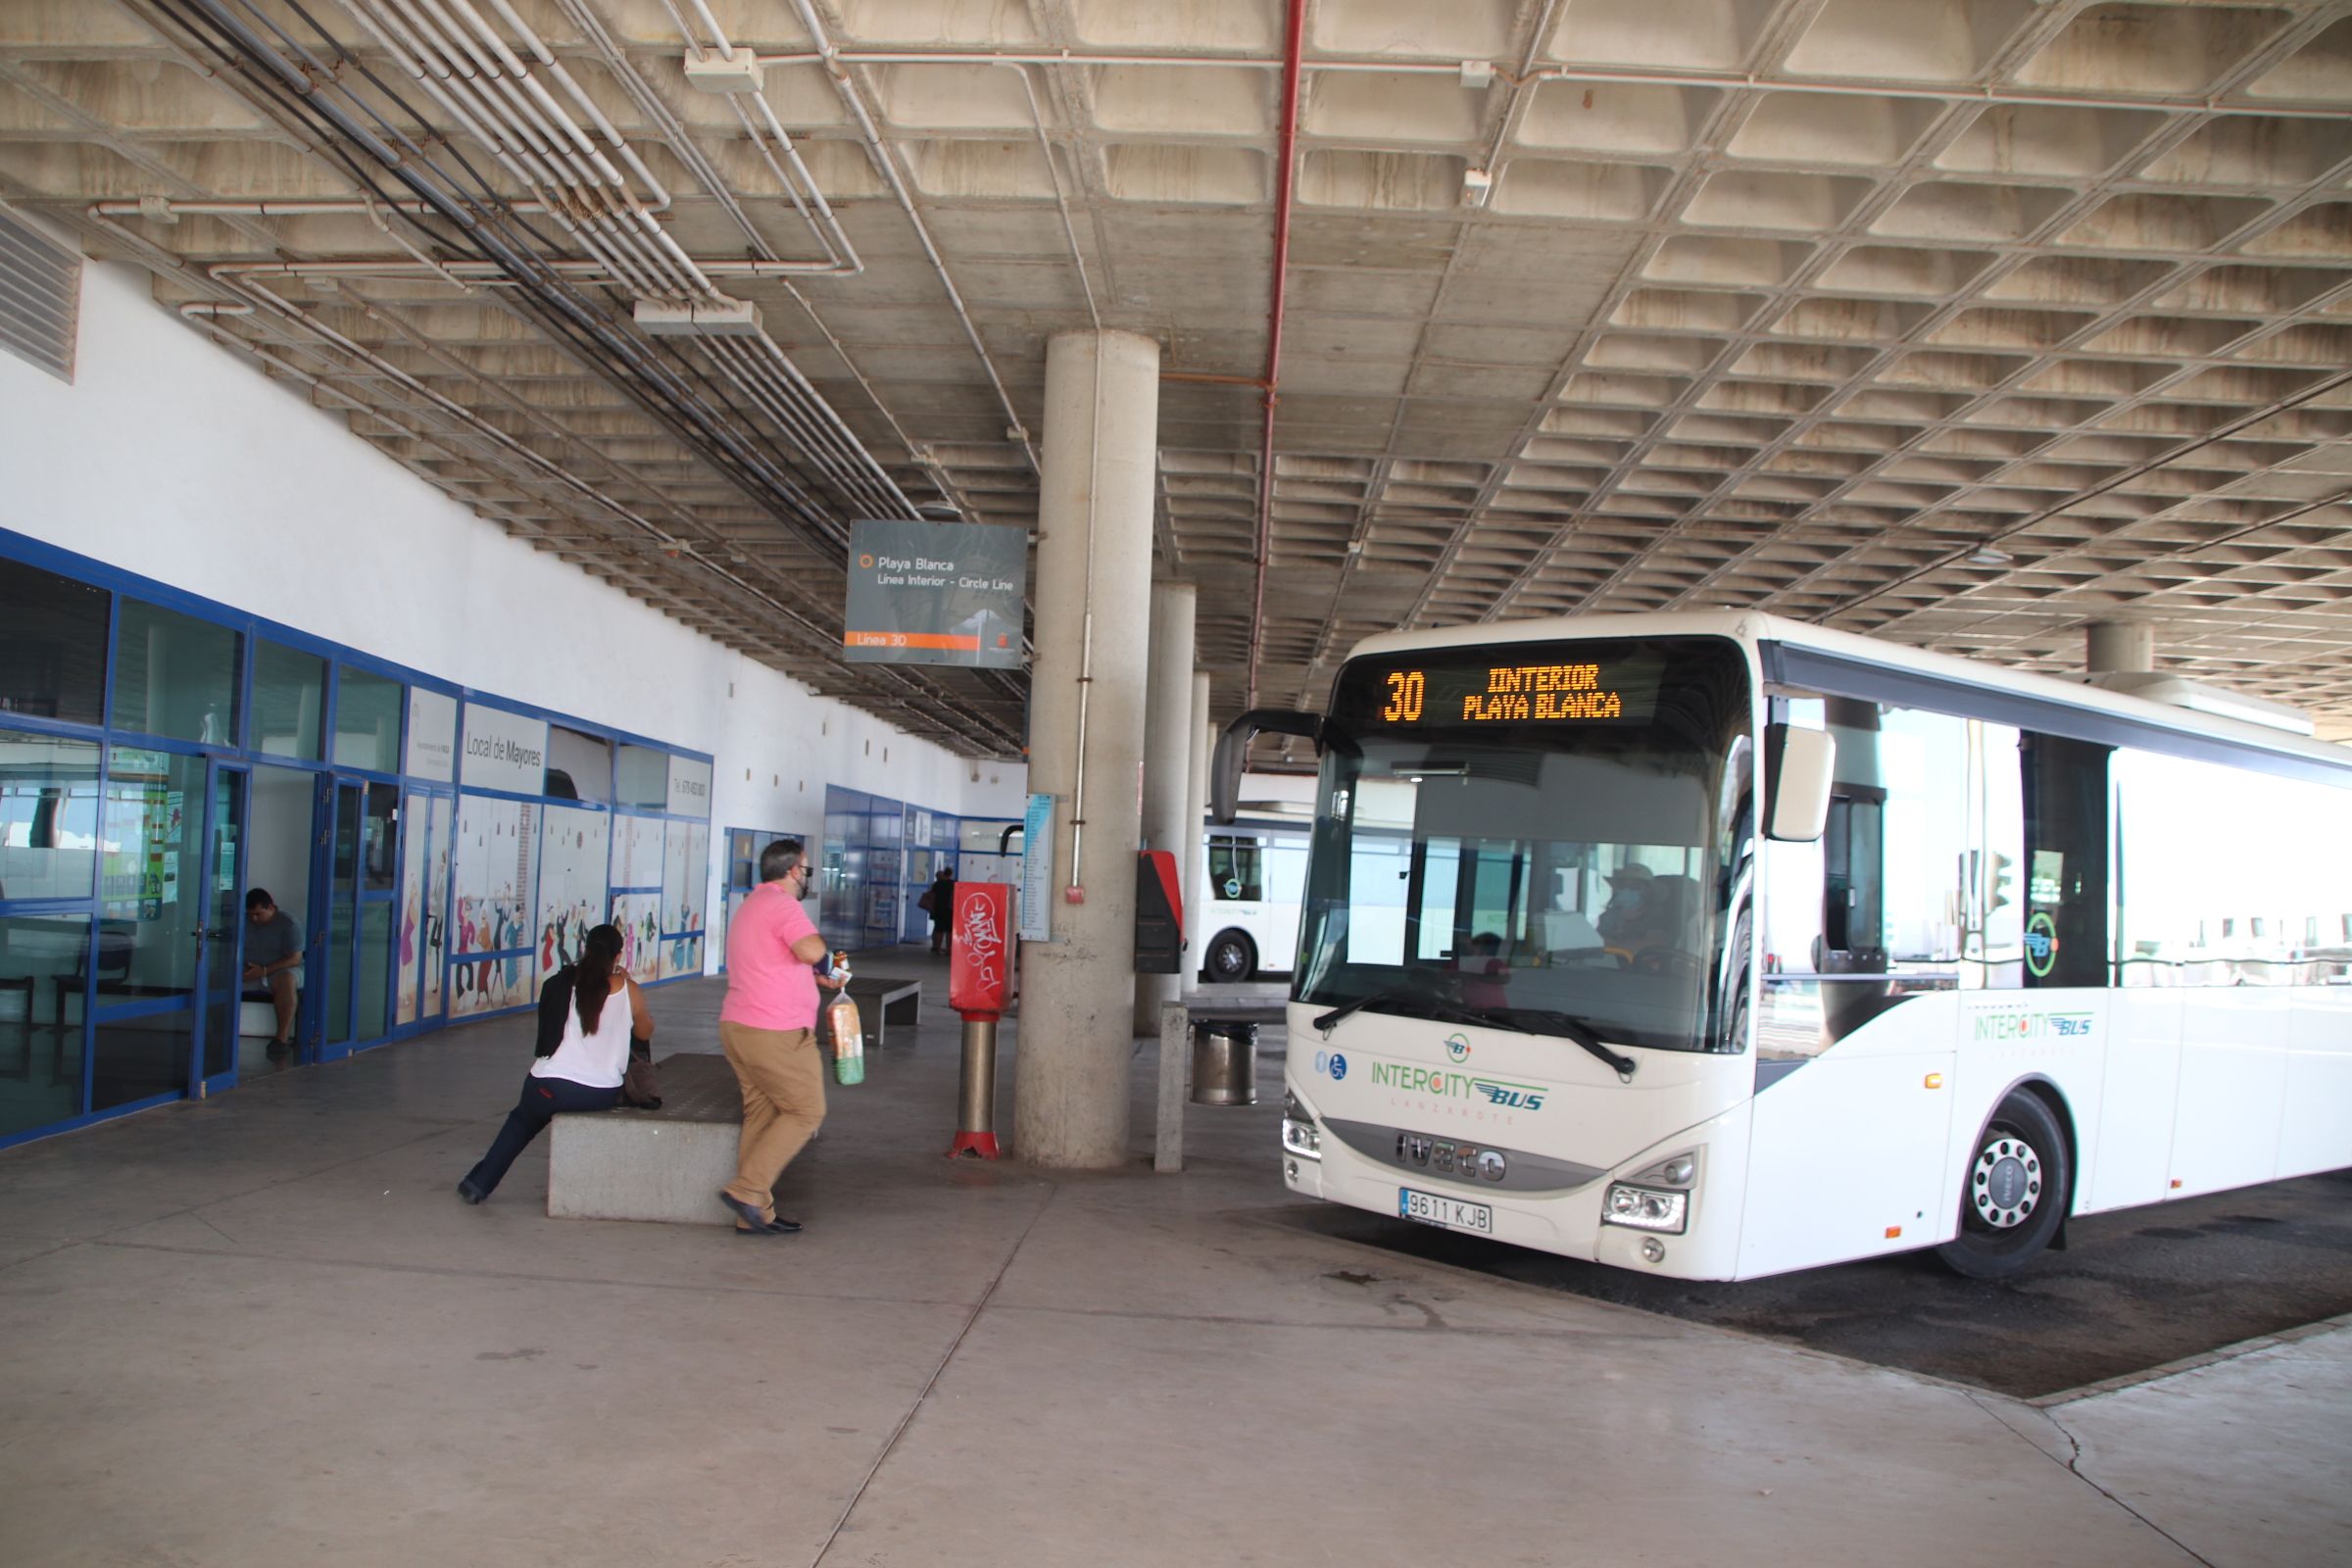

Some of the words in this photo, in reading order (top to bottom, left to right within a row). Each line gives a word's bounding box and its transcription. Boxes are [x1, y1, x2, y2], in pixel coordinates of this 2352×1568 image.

[878, 556, 911, 573] Playa
[915, 557, 955, 571] Blanca
[907, 574, 946, 587] Interior
[958, 576, 989, 589] Circle
[992, 578, 1013, 591] Line
[891, 634, 907, 646] 30
[1383, 671, 1426, 721] 30
[1463, 694, 1529, 720] PLAYA
[1535, 692, 1621, 719] BLANCA
[466, 731, 492, 758] Local
[493, 736, 505, 760] de
[506, 740, 541, 769] Mayores
[1975, 1013, 2049, 1041] INTERCITY
[1372, 1061, 1474, 1099] INTERCITY
[1489, 1087, 1545, 1111] BUS
[1391, 1098, 1514, 1126] LANZAROTE
[1396, 1133, 1506, 1182] IVECO
[1409, 1194, 1447, 1220] 9611
[1455, 1205, 1488, 1229] KJB
